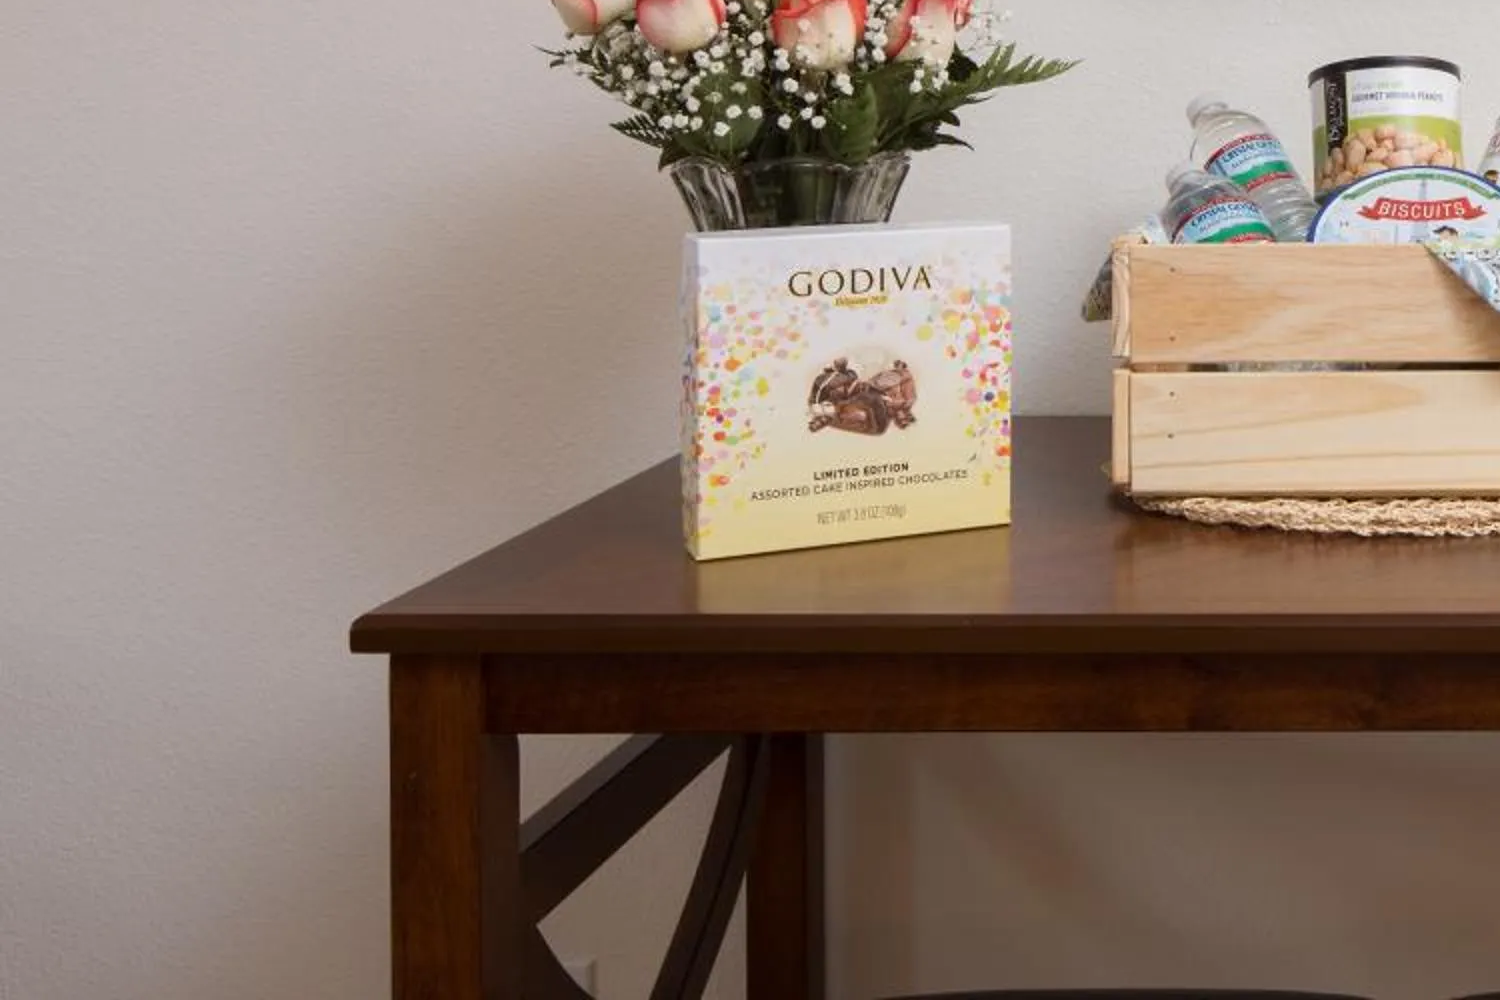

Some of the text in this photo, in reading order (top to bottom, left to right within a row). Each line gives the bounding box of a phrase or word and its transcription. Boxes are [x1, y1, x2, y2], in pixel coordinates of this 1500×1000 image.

[1377, 201, 1465, 220] BISCUITS
[788, 265, 931, 297] GODIVA
[813, 462, 909, 481] LIMITED EDITION
[751, 469, 968, 500] ASSORTED CAKE INSPIRED CHOCOLATES
